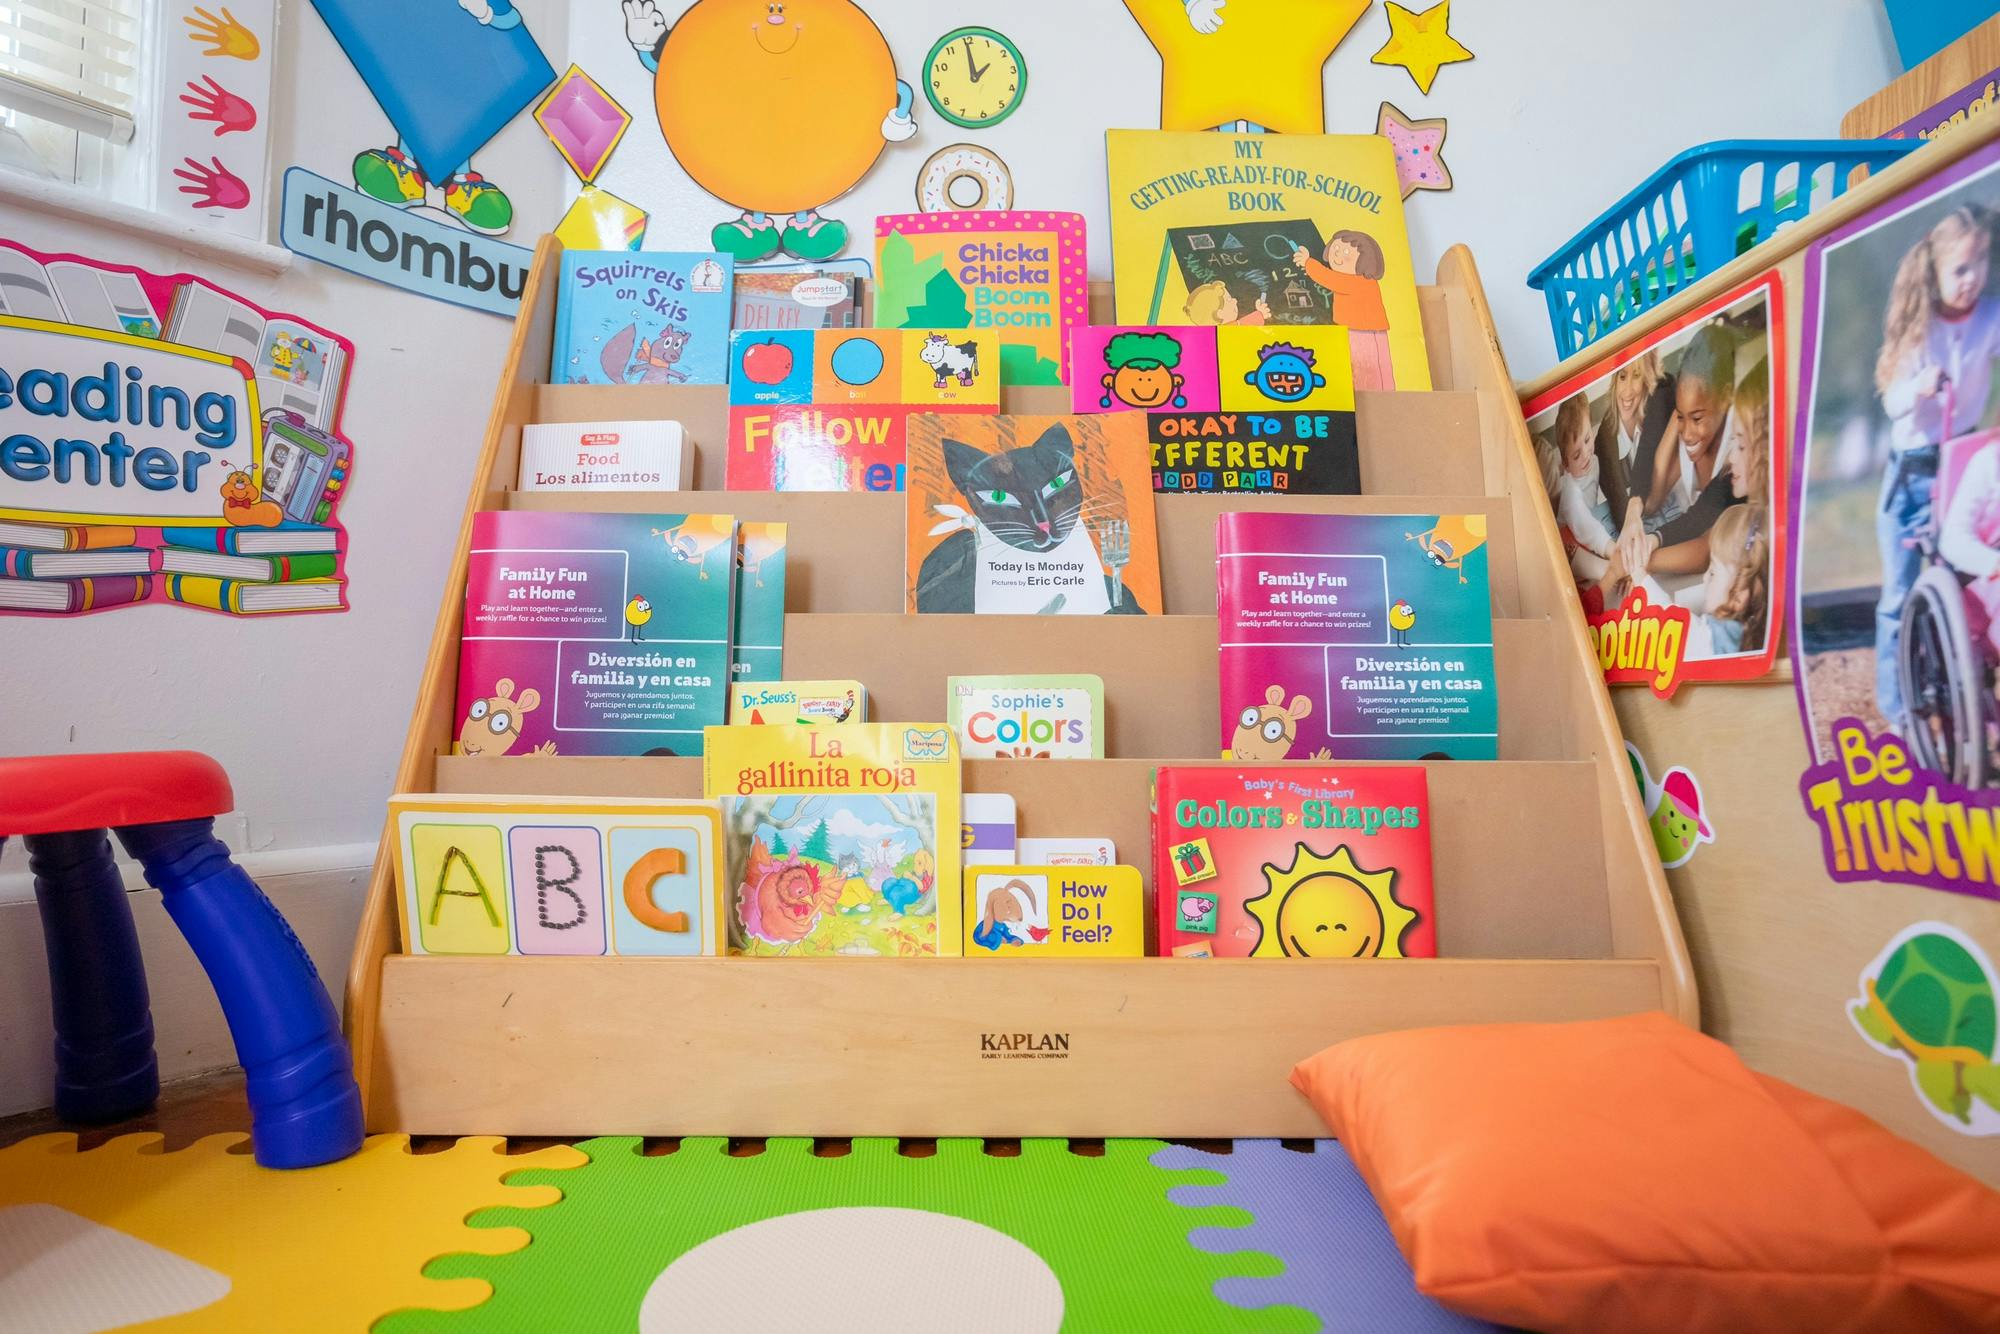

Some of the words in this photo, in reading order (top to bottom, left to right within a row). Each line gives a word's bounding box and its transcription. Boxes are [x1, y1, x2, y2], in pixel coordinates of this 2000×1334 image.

[945, 46, 956, 55] 11
[985, 39, 991, 48] 1
[1000, 49, 1007, 58] 2
[935, 63, 948, 72] 10
[1010, 66, 1017, 75] 3
[933, 81, 941, 89] 9
[1008, 84, 1016, 92] 4
[943, 97, 950, 106] 8
[998, 100, 1005, 109] 5
[959, 108, 966, 117] 7
[980, 110, 987, 119] 6
[1234, 140, 1264, 159] MY
[1130, 165, 1384, 215] GETTING-READY-FOR-SCHOOL
[1228, 191, 1286, 212] BOOK
[302, 191, 529, 299] rhombu
[958, 242, 1049, 262] Chicka
[1208, 252, 1249, 267] ABC
[576, 260, 686, 291] Squirrels
[959, 264, 1049, 284] Chicka
[1283, 267, 1297, 278] 2
[616, 288, 637, 300] on
[642, 287, 688, 322] Skis
[974, 287, 1050, 306] Boom
[974, 308, 1051, 328] Boom
[754, 391, 780, 400] apple
[0, 361, 236, 448] ading
[745, 410, 891, 452] Follow
[1159, 415, 1238, 437] OKAY
[1247, 415, 1282, 437] TO
[1294, 415, 1330, 439] BE
[576, 453, 620, 466] Food
[535, 472, 566, 485] Los
[571, 471, 660, 484] alimentos
[1223, 471, 1287, 489] PARR
[988, 561, 1023, 573] Today
[1025, 561, 1036, 572] Is
[1037, 561, 1084, 573] Monday
[499, 567, 555, 584] Family
[558, 568, 588, 581] Fun
[991, 579, 1018, 587] Pictures
[1018, 580, 1027, 588] by
[1027, 576, 1051, 586] Eric
[1053, 576, 1085, 586] Carle
[1258, 571, 1315, 589] Family
[1318, 572, 1348, 587] Fun
[508, 588, 526, 599] at
[529, 586, 576, 600] Home
[1270, 593, 1288, 604] at
[1291, 590, 1338, 604] Home
[480, 604, 496, 613] Play
[496, 604, 509, 612] and
[510, 604, 529, 612] learn
[1241, 609, 1258, 618] Play
[1258, 609, 1272, 617] and
[475, 614, 498, 623] weekly
[499, 614, 517, 622] raffle
[518, 614, 529, 622] for
[584, 616, 608, 624] prizes!
[1236, 620, 1261, 628] weekly
[1300, 620, 1324, 628] chance
[1347, 621, 1371, 629] prizes!
[588, 652, 673, 668] Diversión
[676, 656, 696, 668] en
[731, 662, 751, 673] en
[1355, 656, 1441, 671] Diversión
[1443, 661, 1464, 671] en
[571, 670, 634, 685] familia
[638, 674, 648, 689] y
[651, 675, 671, 686] en
[674, 675, 711, 687] casa
[1340, 676, 1405, 690] familia
[1408, 679, 1418, 694] y
[1421, 679, 1442, 690] en
[1445, 679, 1482, 690] casa
[585, 690, 621, 700] Juguemos
[626, 691, 670, 700] aprendamos
[742, 694, 760, 709] Dr.
[760, 690, 797, 705] Seuss's
[991, 694, 1064, 712] Sophie's
[1357, 696, 1393, 704] Juguemos
[1399, 696, 1443, 704] aprendamos
[590, 701, 627, 710] participen
[652, 701, 665, 709] rifa
[1363, 706, 1400, 715] participen
[644, 712, 675, 720] premios!
[967, 711, 1084, 744] Colors
[808, 732, 844, 759] La
[1838, 727, 1913, 786] Be
[737, 761, 851, 796] gallinita
[861, 760, 917, 793] roja
[1244, 778, 1285, 791] Baby's
[1288, 782, 1312, 797] First
[1315, 788, 1355, 800] Library
[1175, 799, 1284, 829] Colors
[1286, 812, 1298, 825] &
[1301, 799, 1420, 836] Shapes
[429, 846, 502, 928] A
[535, 845, 589, 930] B
[623, 847, 690, 934] C
[1061, 881, 1108, 898] How
[1062, 903, 1090, 921] Do
[1097, 903, 1102, 920] I
[1062, 925, 1113, 943] Feel?
[981, 1033, 1070, 1051] KAPLAN
